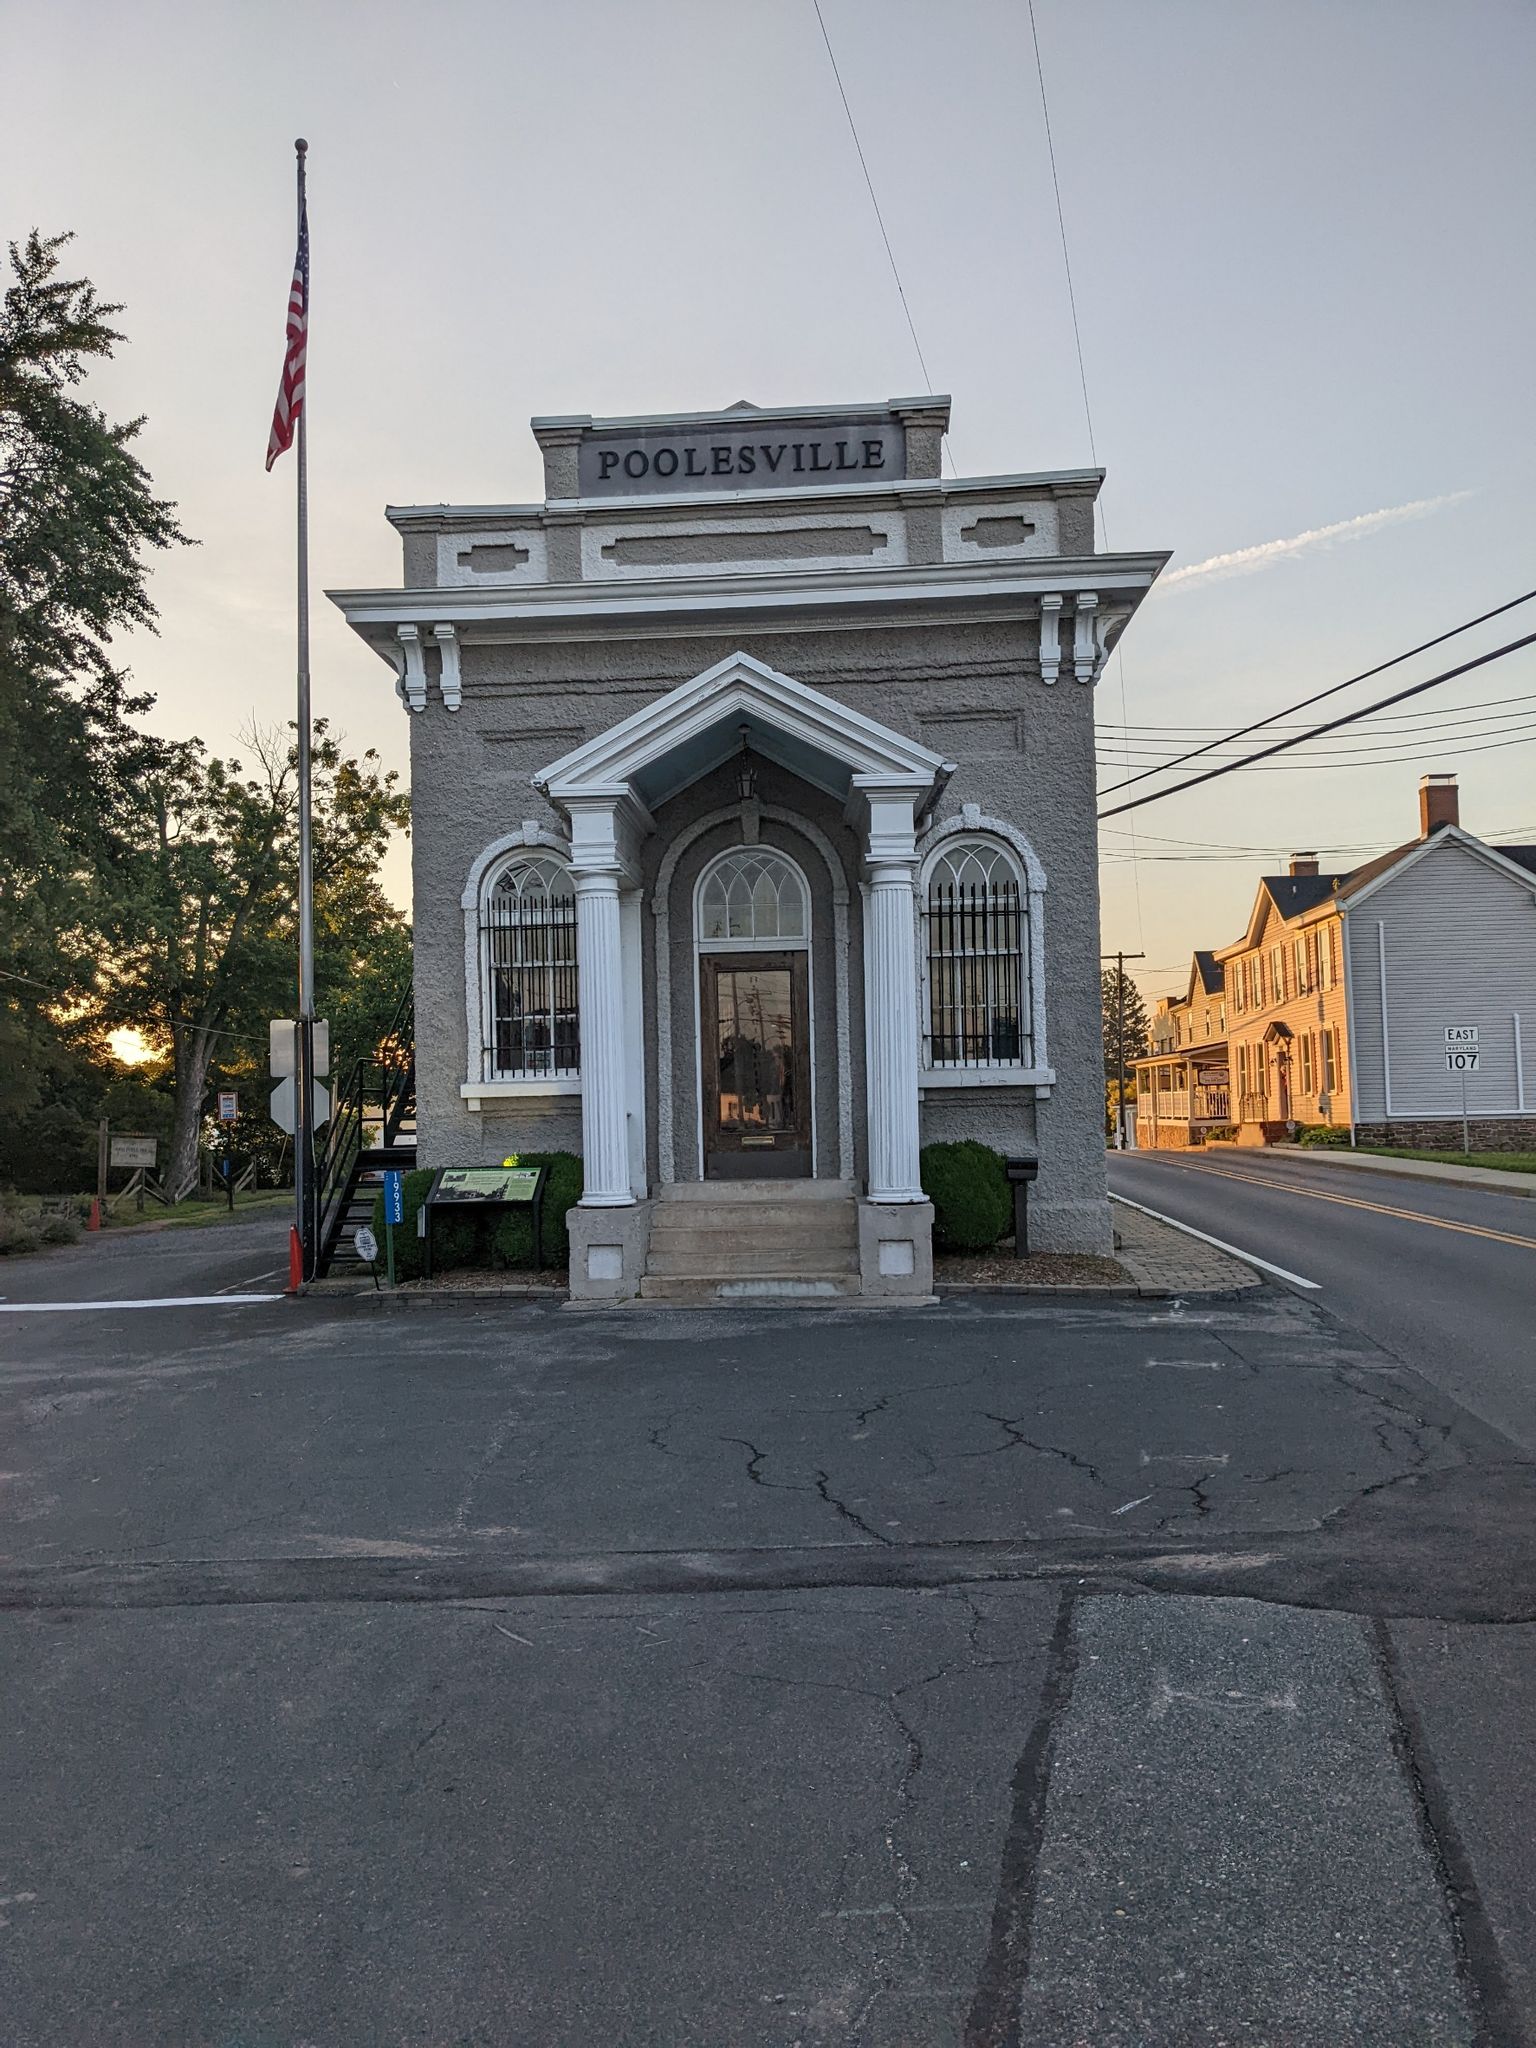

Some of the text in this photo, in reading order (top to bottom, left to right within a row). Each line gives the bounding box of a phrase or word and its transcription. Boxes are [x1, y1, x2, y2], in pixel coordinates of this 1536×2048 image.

[598, 440, 885, 479] POOLESVILLE
[1448, 1029, 1474, 1040] EAST
[1448, 1055, 1477, 1069] 107
[393, 1171, 401, 1222] 19933
